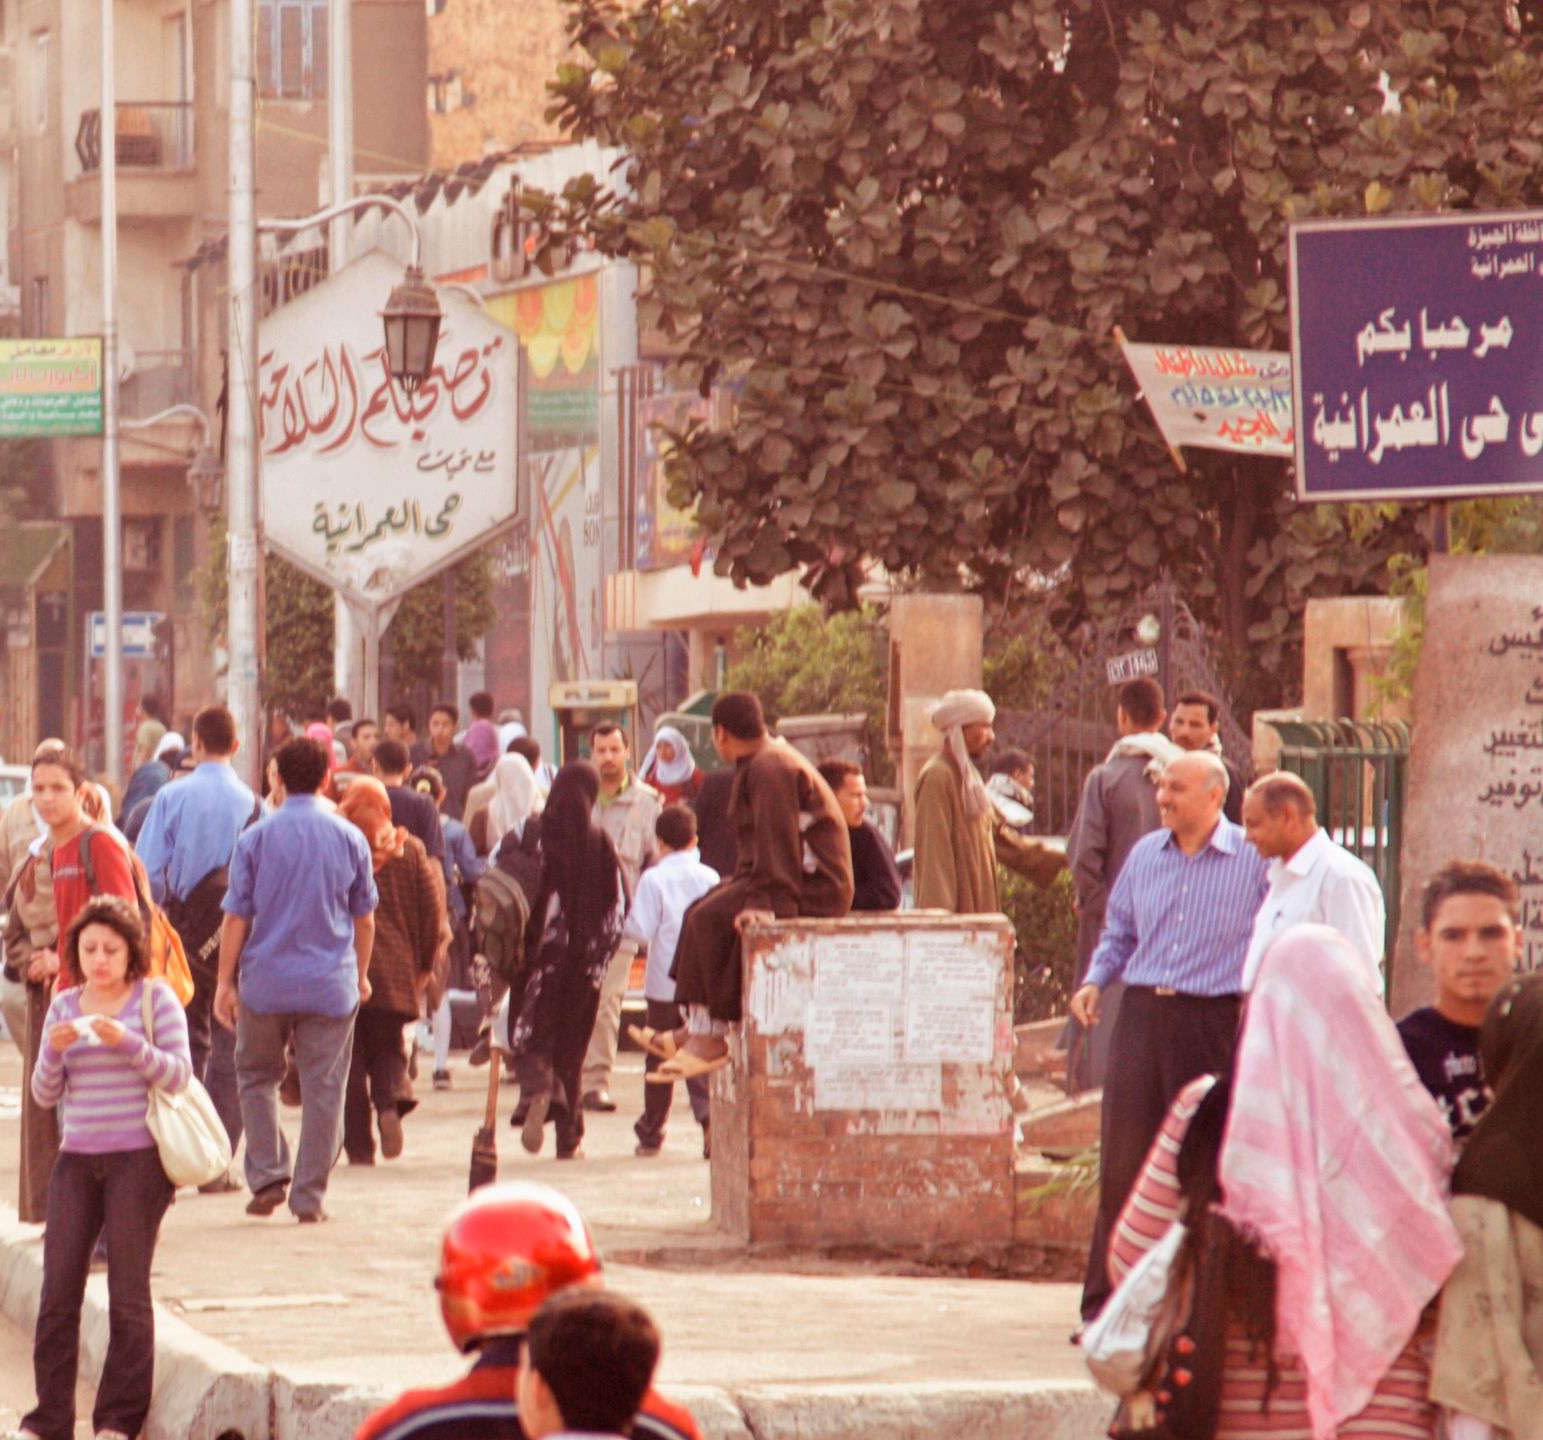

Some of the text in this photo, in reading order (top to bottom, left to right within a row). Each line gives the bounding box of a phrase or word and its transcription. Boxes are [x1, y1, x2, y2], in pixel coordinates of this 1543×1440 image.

[1356, 306, 1514, 368] مرحبا بكم
[1313, 380, 1450, 464] العمرانية
[1461, 395, 1510, 459] حى
[416, 448, 473, 482] تحيات
[312, 492, 462, 554] حى العمرانية
